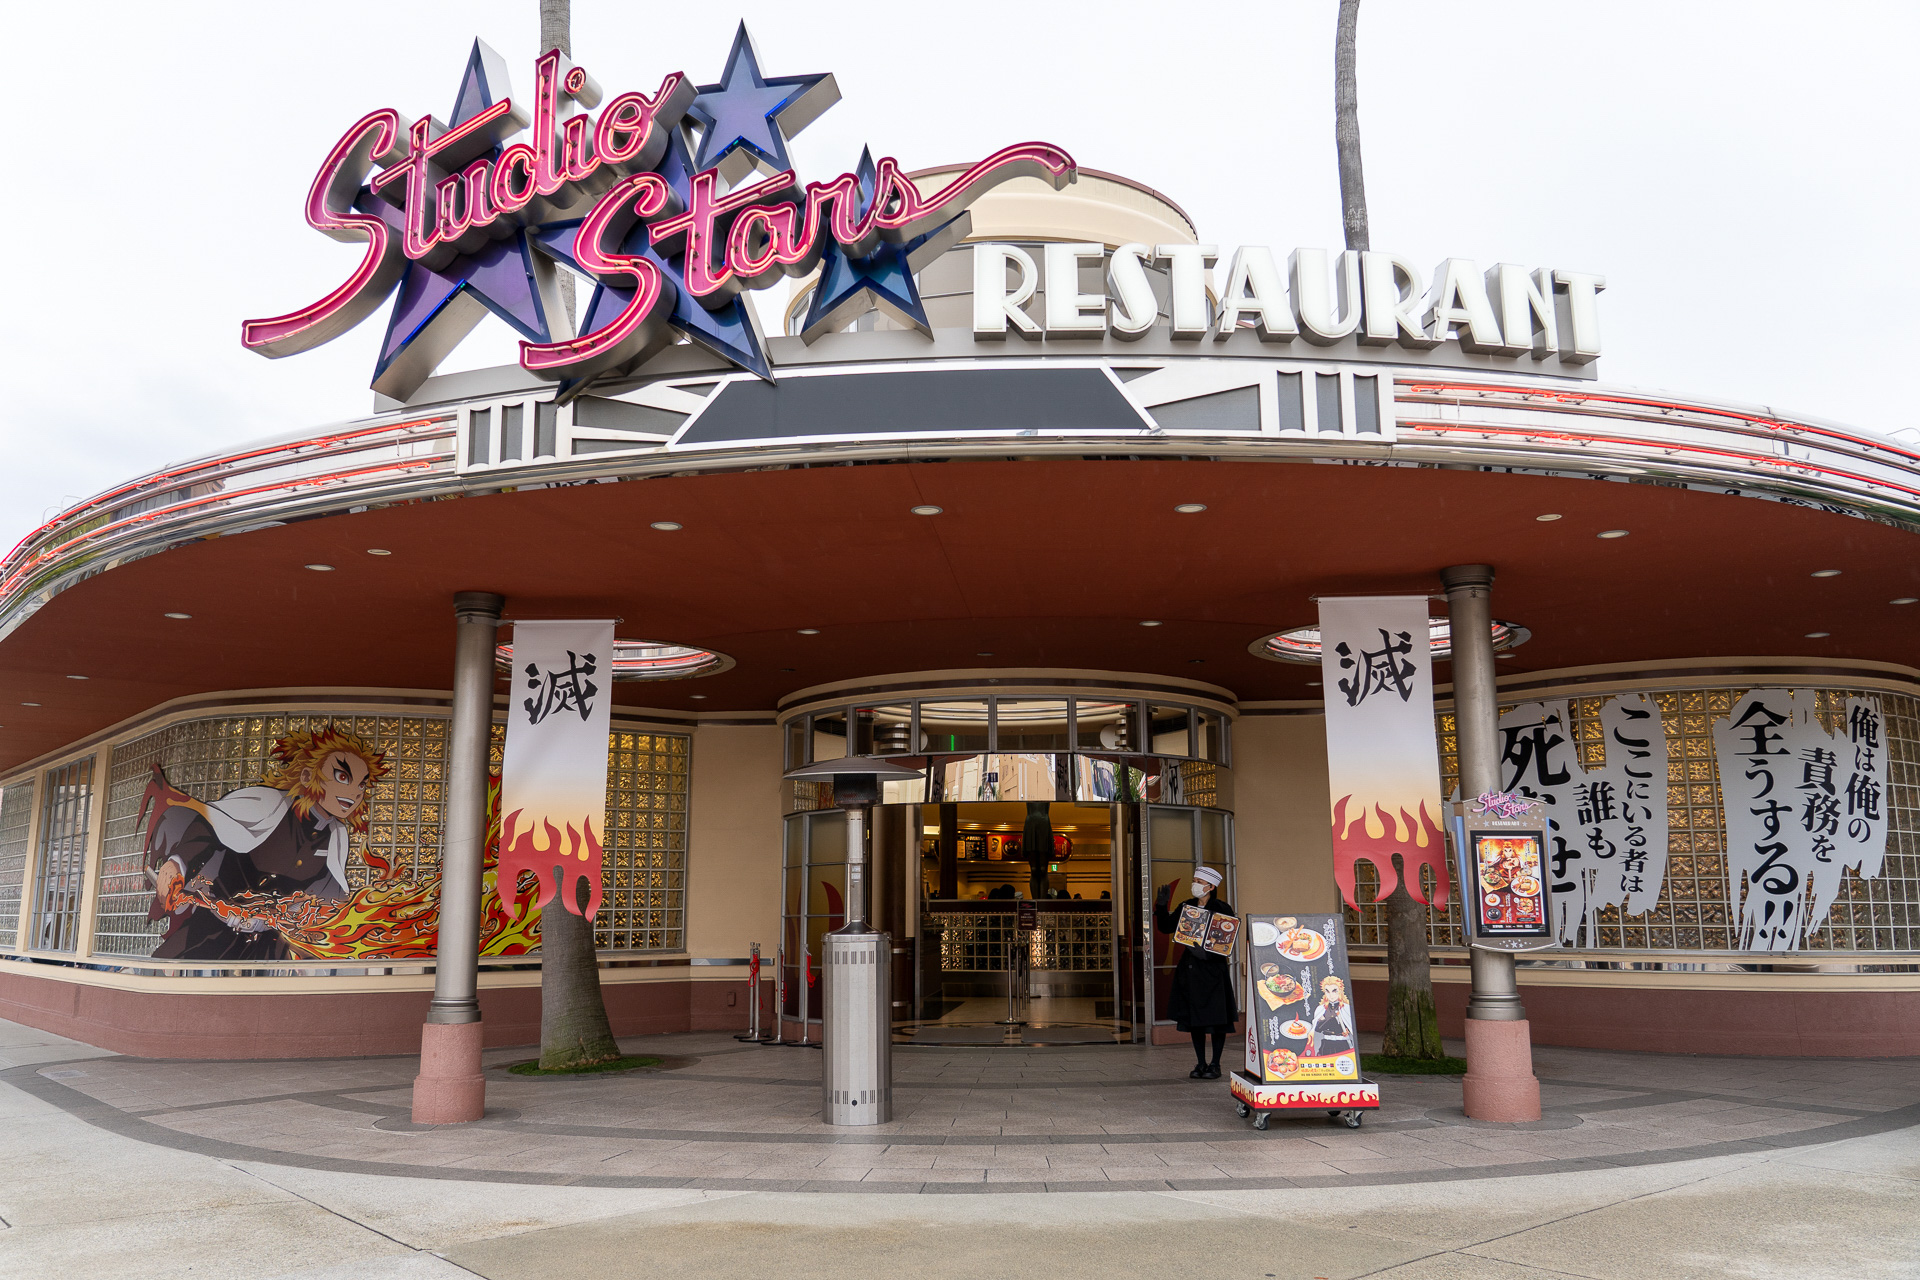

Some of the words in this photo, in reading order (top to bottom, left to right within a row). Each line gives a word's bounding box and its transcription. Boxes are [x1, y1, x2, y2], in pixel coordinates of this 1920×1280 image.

[242, 48, 687, 353] Studio
[520, 141, 1078, 372] Stars
[973, 243, 1606, 364] RESTAURANT
[523, 649, 598, 725] 滅
[1334, 628, 1417, 707] 滅
[1573, 781, 1619, 859] 誰も
[1613, 706, 1653, 893] ここにいる者は
[1794, 747, 1842, 862] 責務を
[1844, 704, 1881, 843] 俺は俺の
